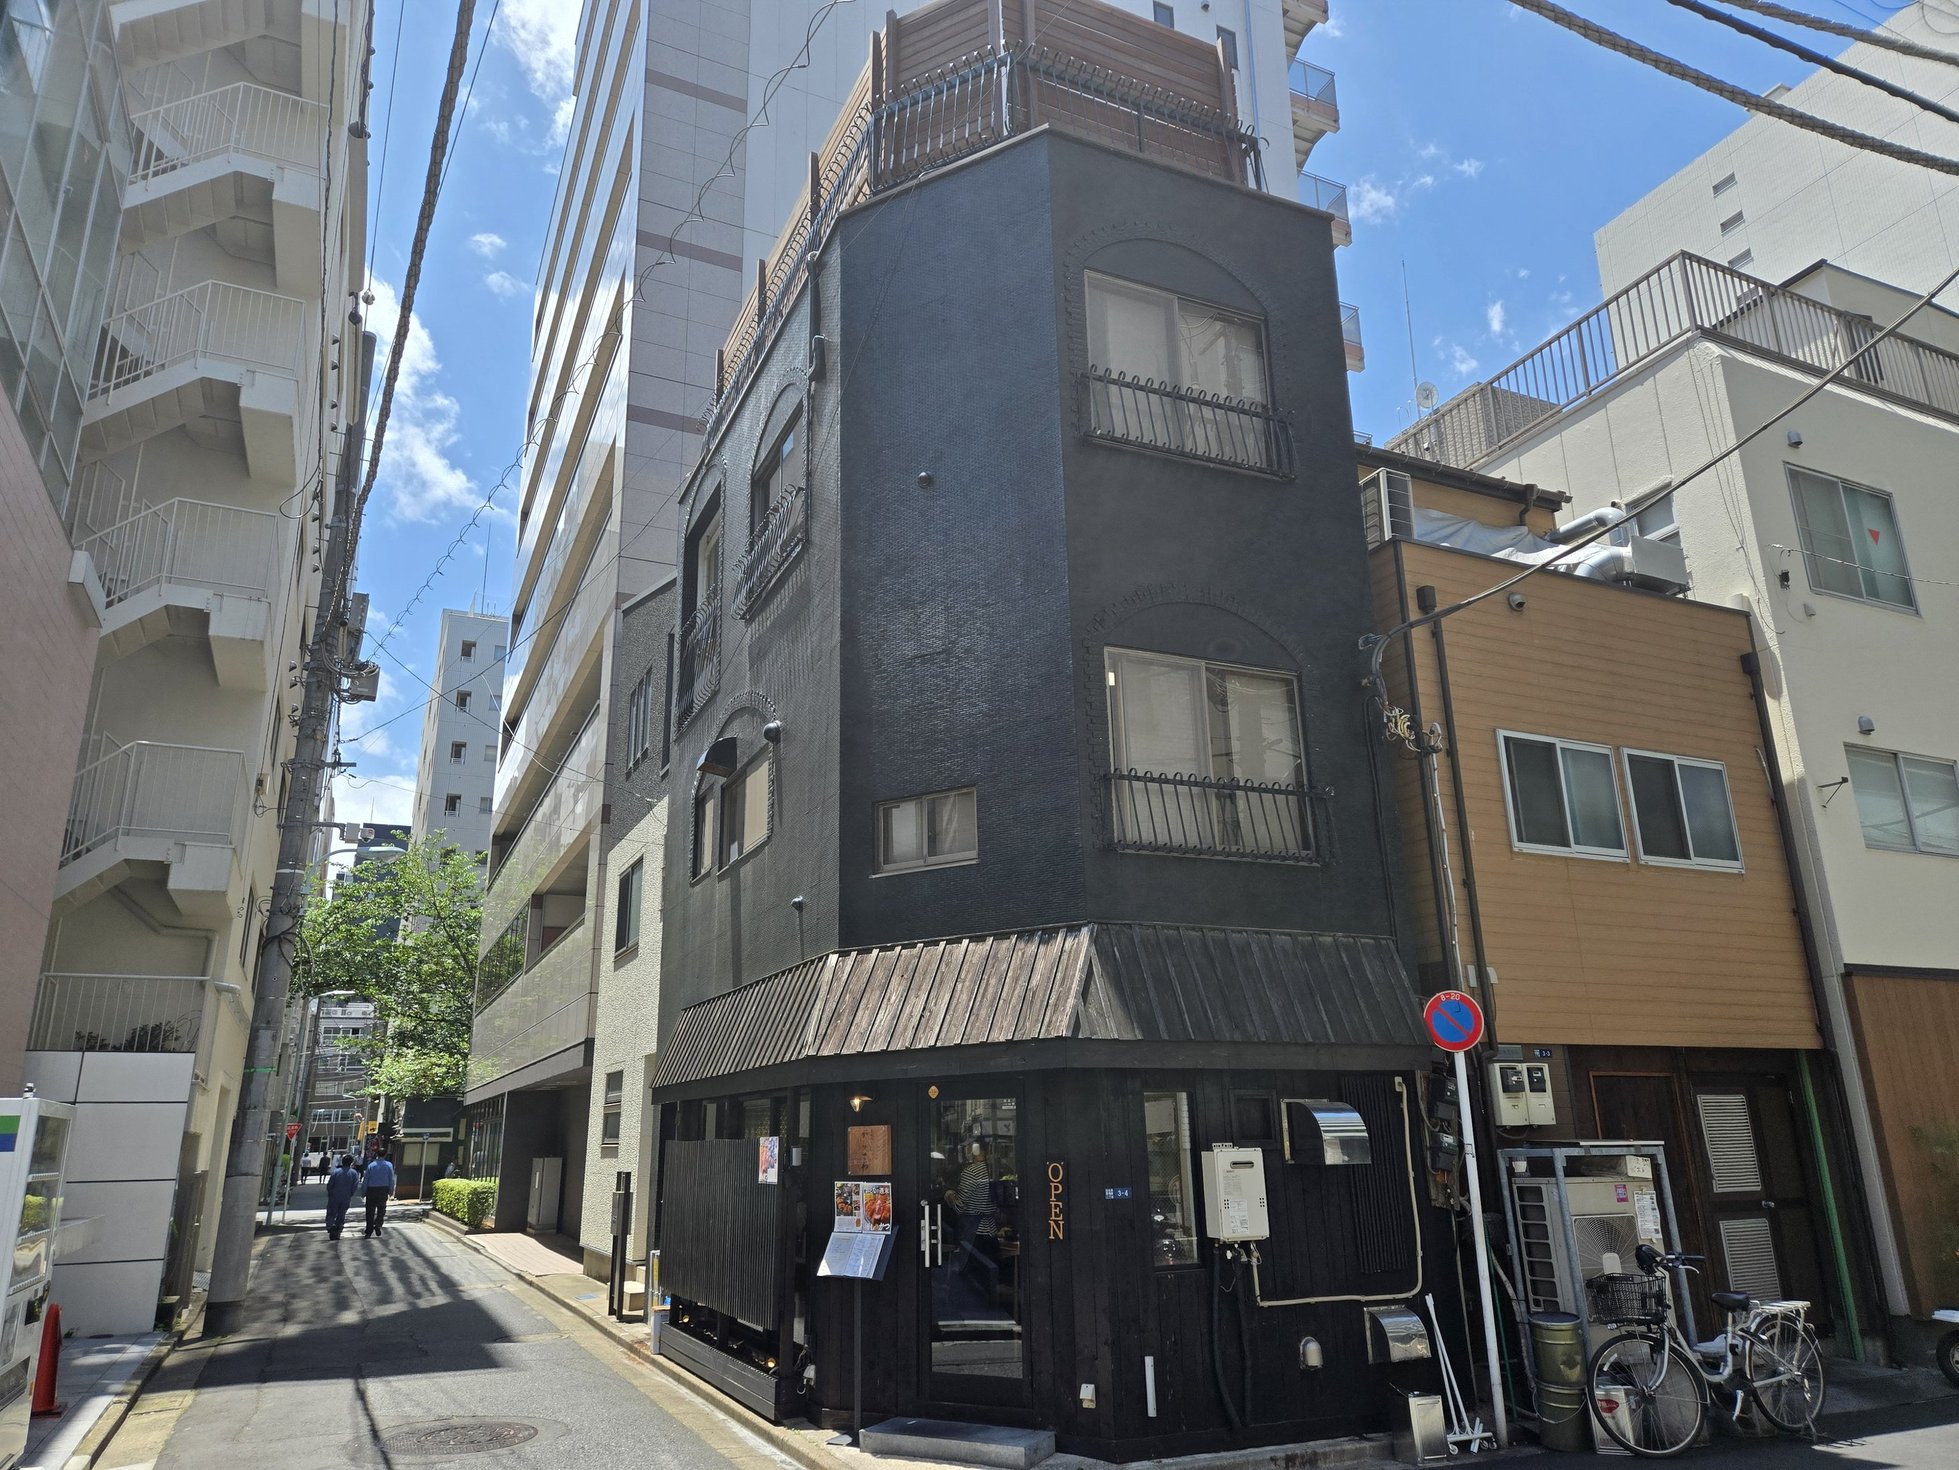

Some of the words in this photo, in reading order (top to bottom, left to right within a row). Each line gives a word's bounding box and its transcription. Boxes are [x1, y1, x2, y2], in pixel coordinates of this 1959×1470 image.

[1440, 993, 1460, 1001] 8-20
[1117, 1189, 1129, 1197] 3-4
[1048, 1163, 1064, 1240] OPEN
